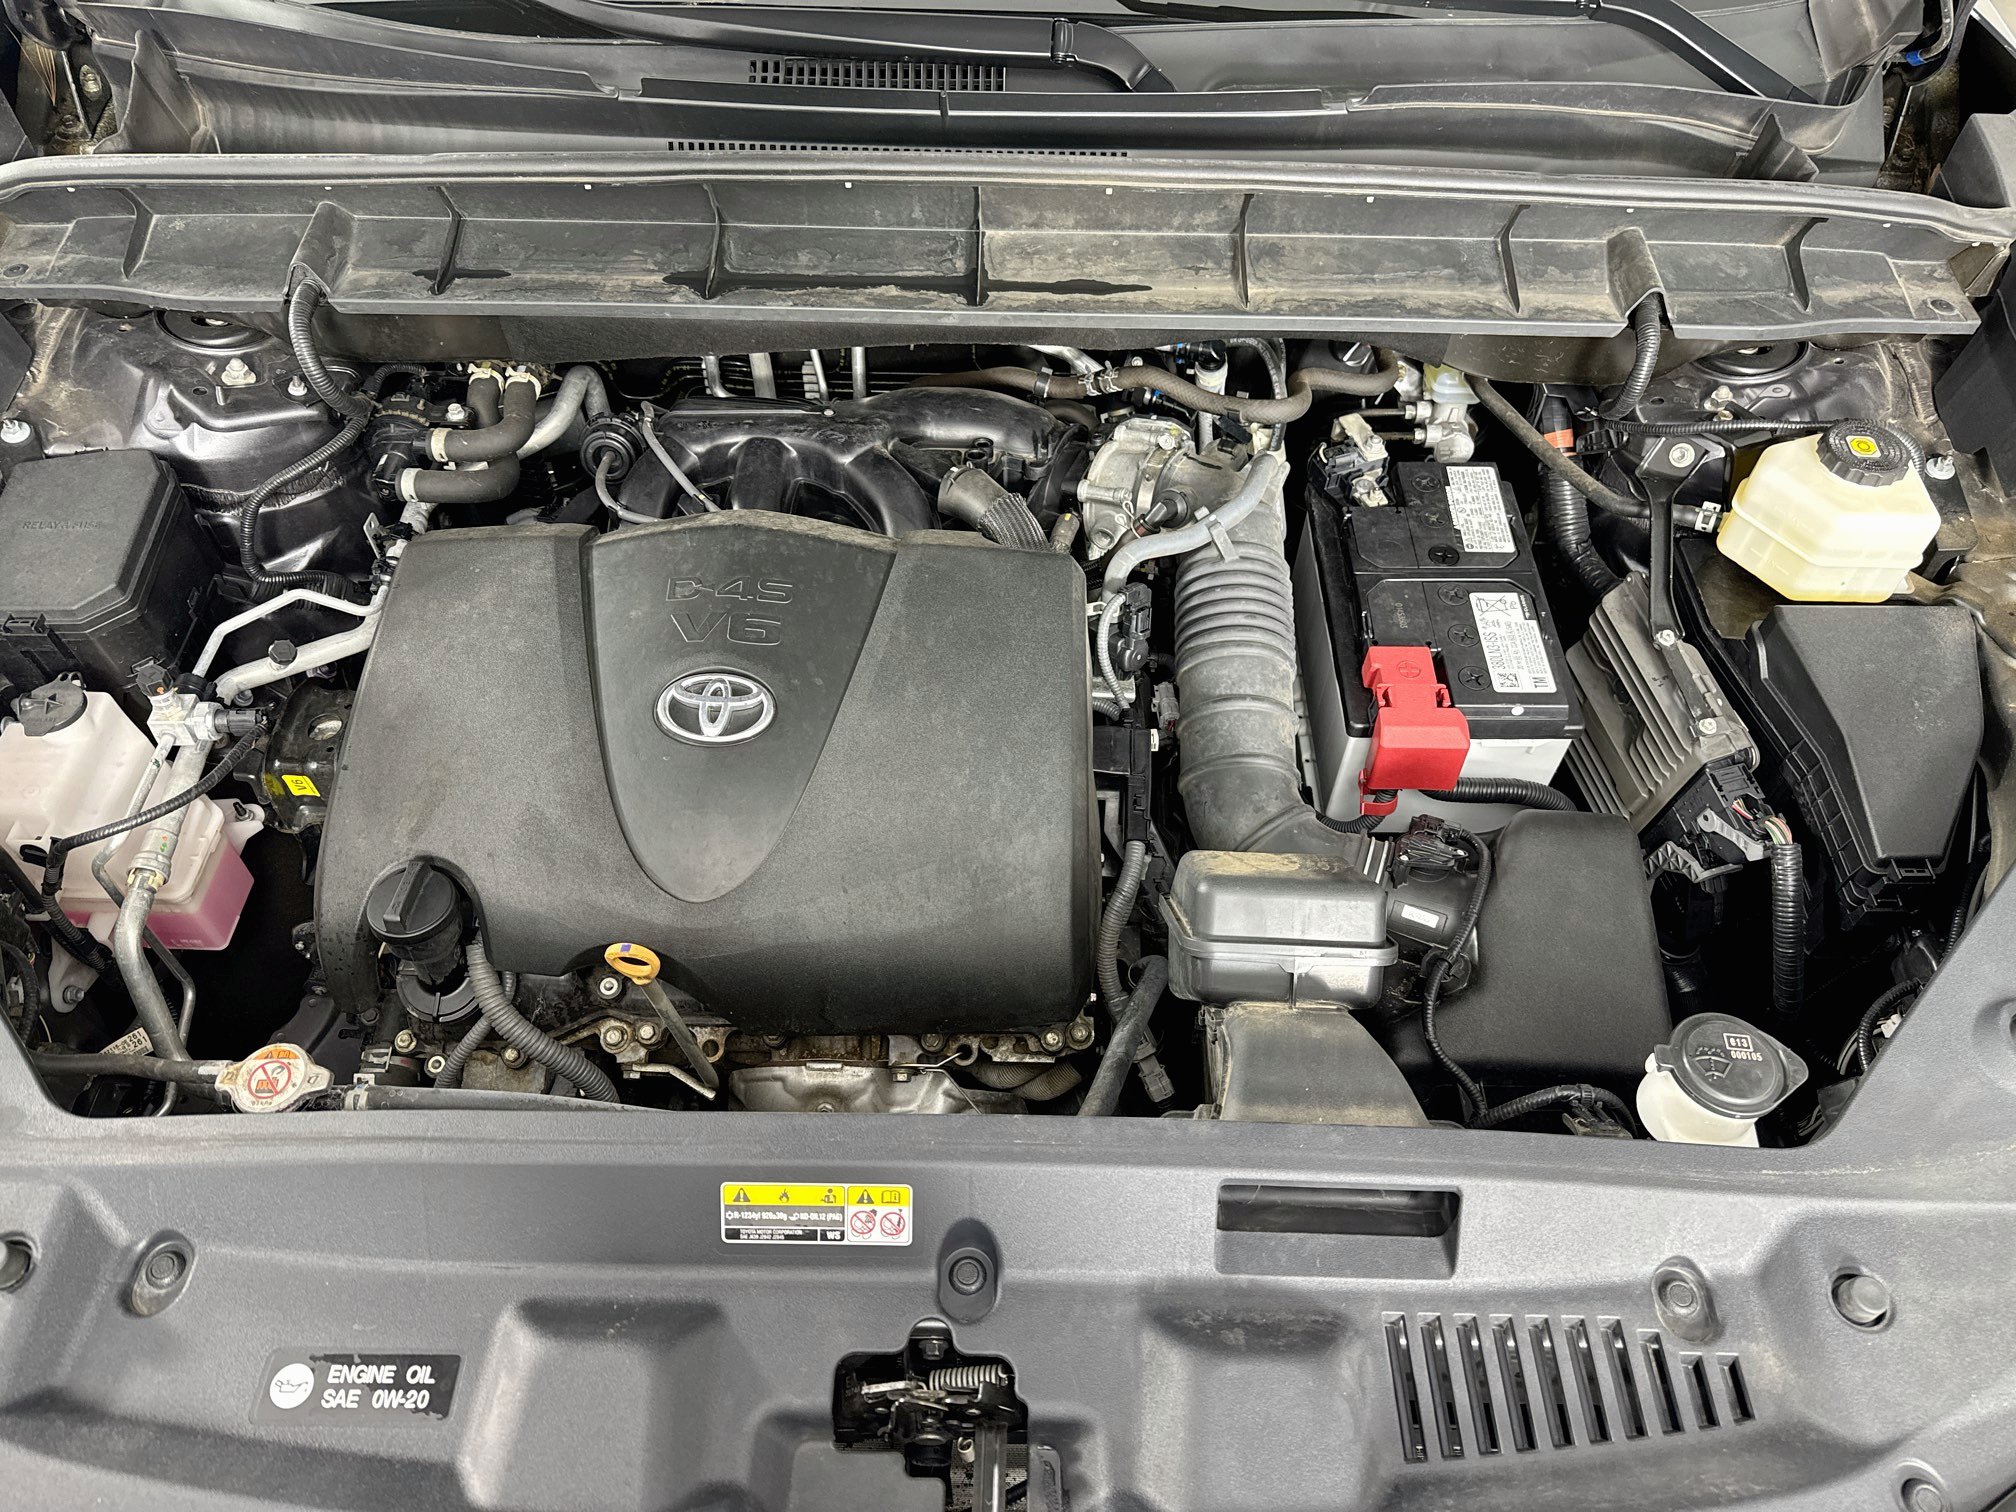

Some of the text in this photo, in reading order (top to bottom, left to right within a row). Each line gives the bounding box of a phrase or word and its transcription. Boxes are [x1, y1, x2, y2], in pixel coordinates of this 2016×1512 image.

[665, 575, 793, 604] D-4S
[669, 611, 782, 646] V6
[1532, 676, 1549, 688] TM
[131, 1036, 148, 1048] 261
[1730, 1050, 1762, 1061] 000105
[826, 1230, 841, 1240] WS
[327, 1364, 436, 1385] ENGINE OIL
[320, 1388, 430, 1409] SAE 0W-20
